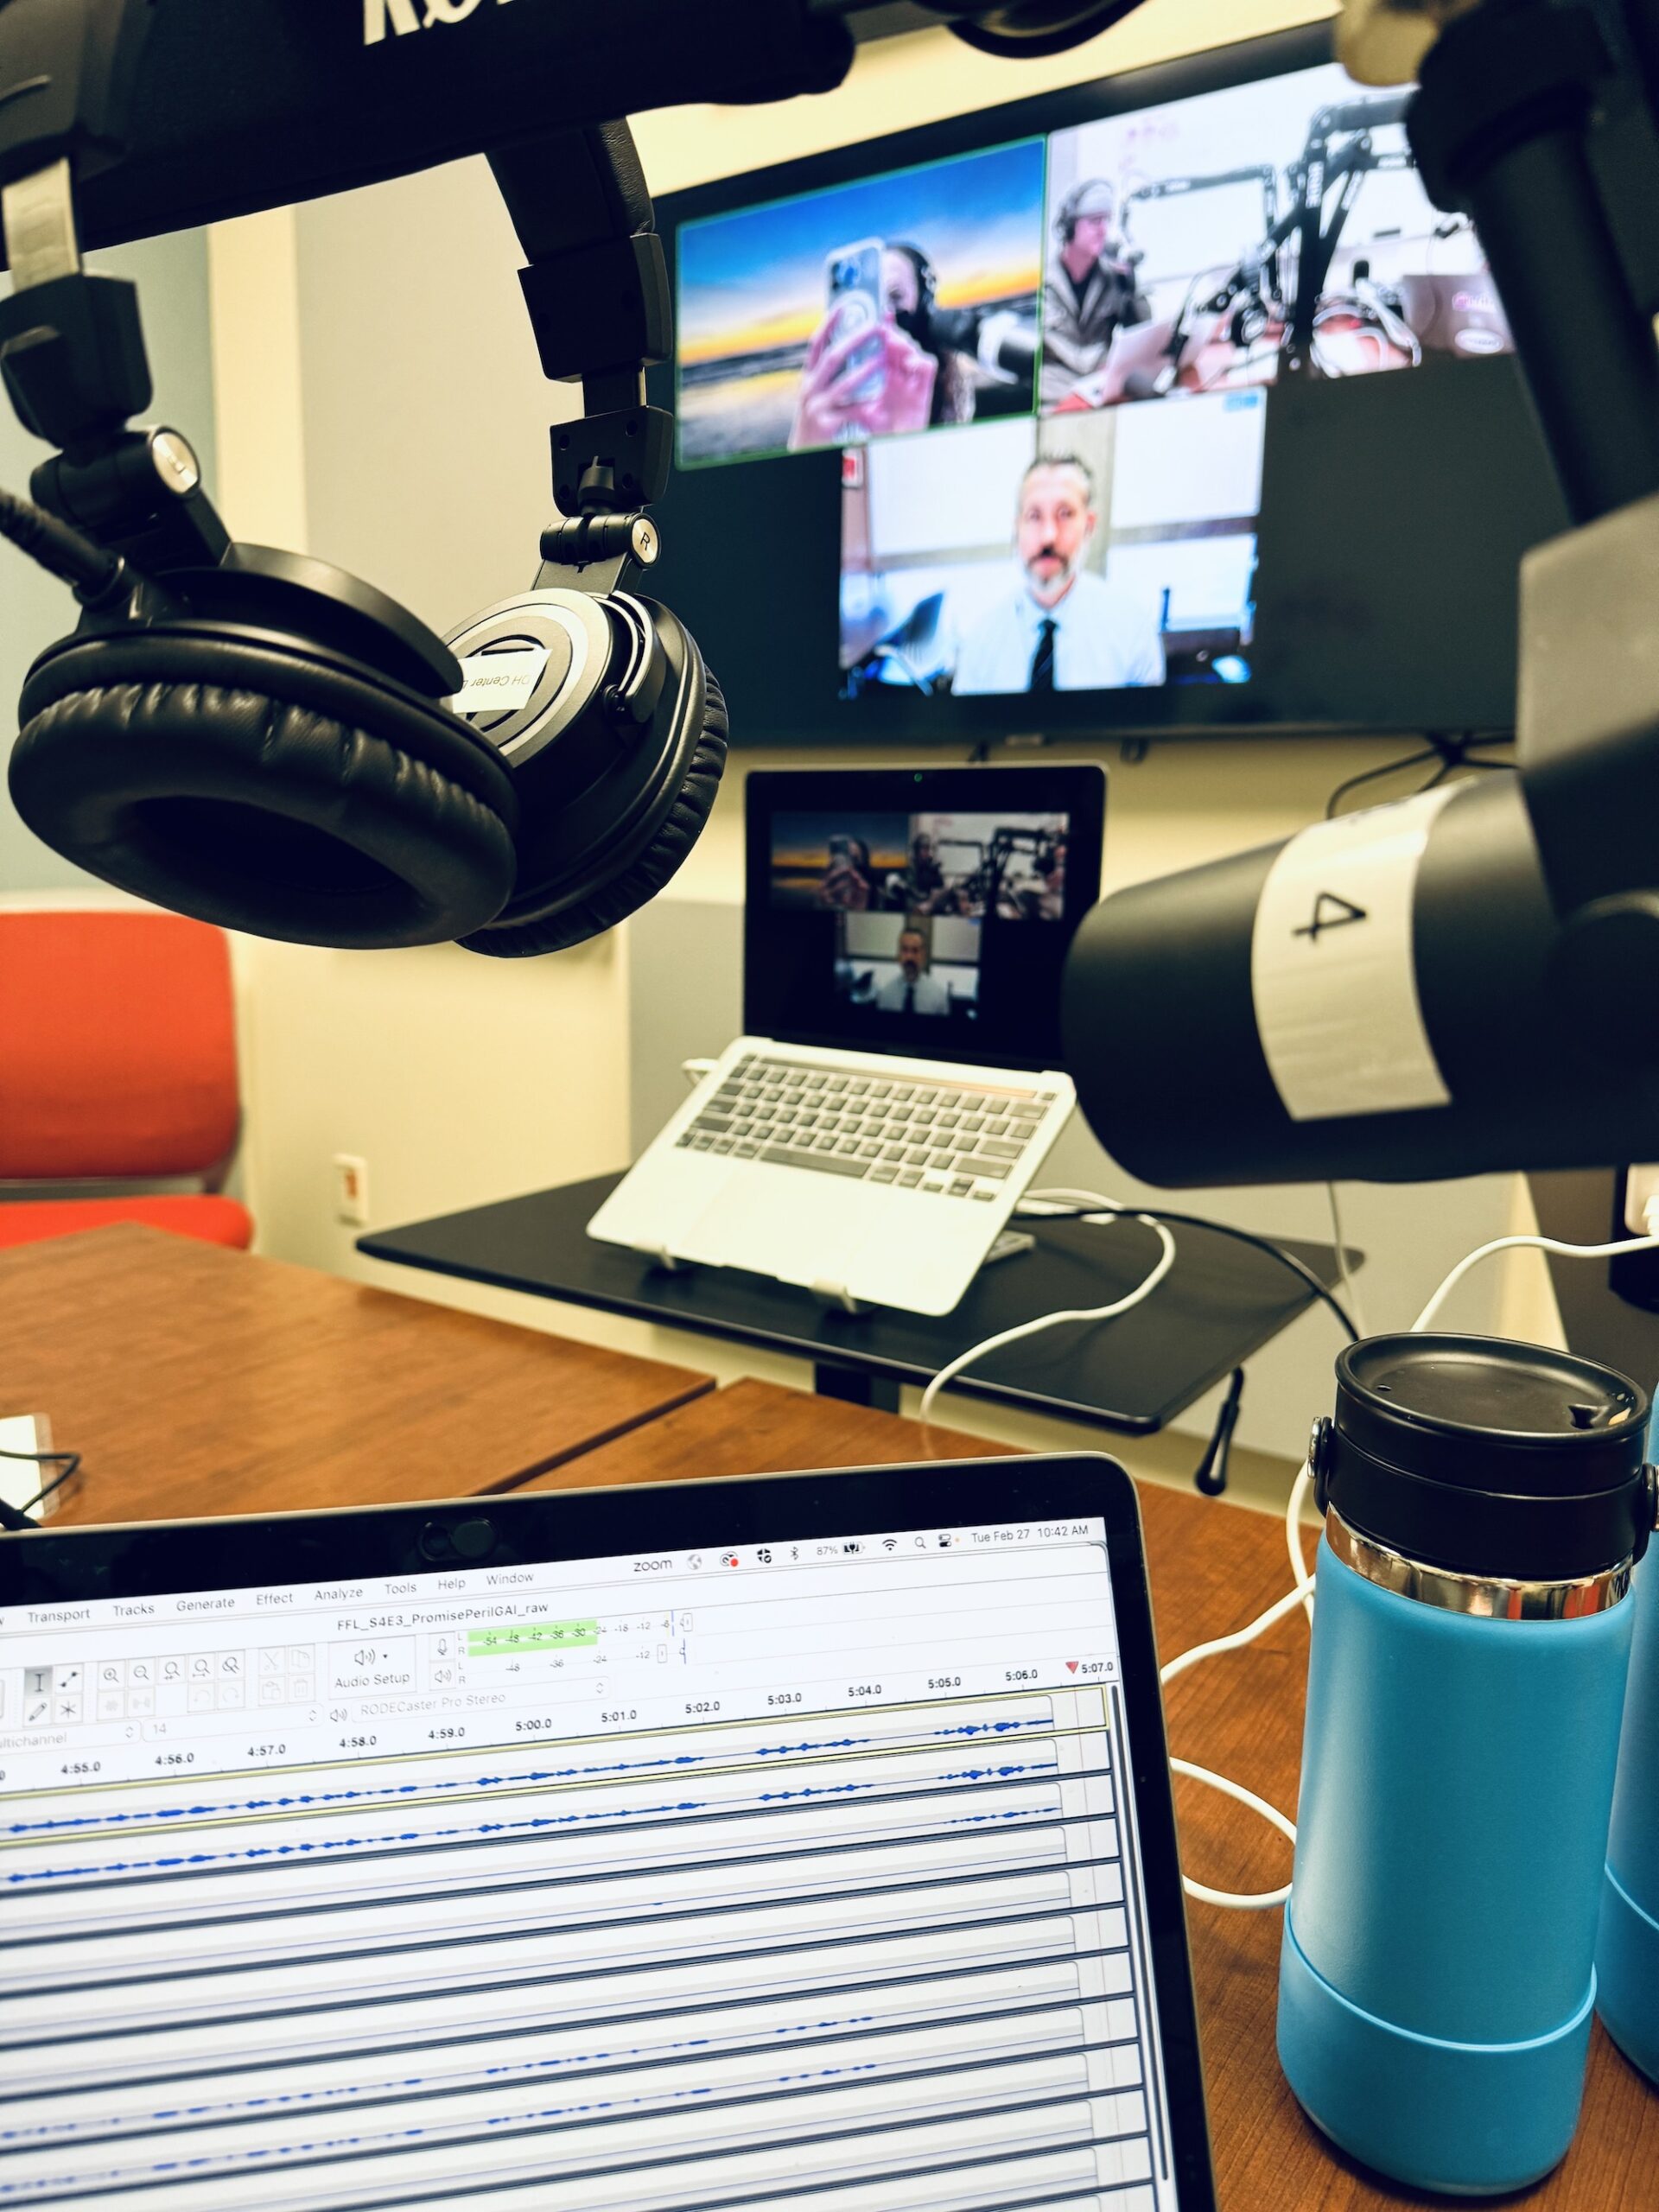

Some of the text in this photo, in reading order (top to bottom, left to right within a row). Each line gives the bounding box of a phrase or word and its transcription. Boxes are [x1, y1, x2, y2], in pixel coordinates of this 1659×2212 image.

[640, 531, 651, 550] R
[470, 676, 510, 687] Center
[1293, 892, 1367, 944] 4
[971, 1524, 1090, 1543] Tue Feb 27 10:42 AM
[633, 1558, 673, 1572] zoom
[28, 1573, 534, 1625] Transport Tracks Generate Effect Analyze Tools Help Window
[334, 1671, 410, 1690] Audio Setup
[360, 1691, 505, 1716] RODECaster Pro Stereo
[61, 1761, 101, 1774] 4:55.0
[247, 1743, 286, 1757] 4:57.0
[339, 1735, 377, 1748] 4:58.0
[428, 1726, 466, 1739] 4:59.0
[516, 1718, 552, 1732] 5:00.0
[601, 1710, 637, 1722] 5:01.0
[685, 1700, 721, 1713] 5:02.0
[767, 1692, 802, 1705] 5:03.0
[849, 1684, 882, 1697] 5:04.0
[928, 1676, 961, 1688] 5:05.0
[1005, 1669, 1038, 1681] 5:06.0
[1081, 1662, 1114, 1674] 5:07.0
